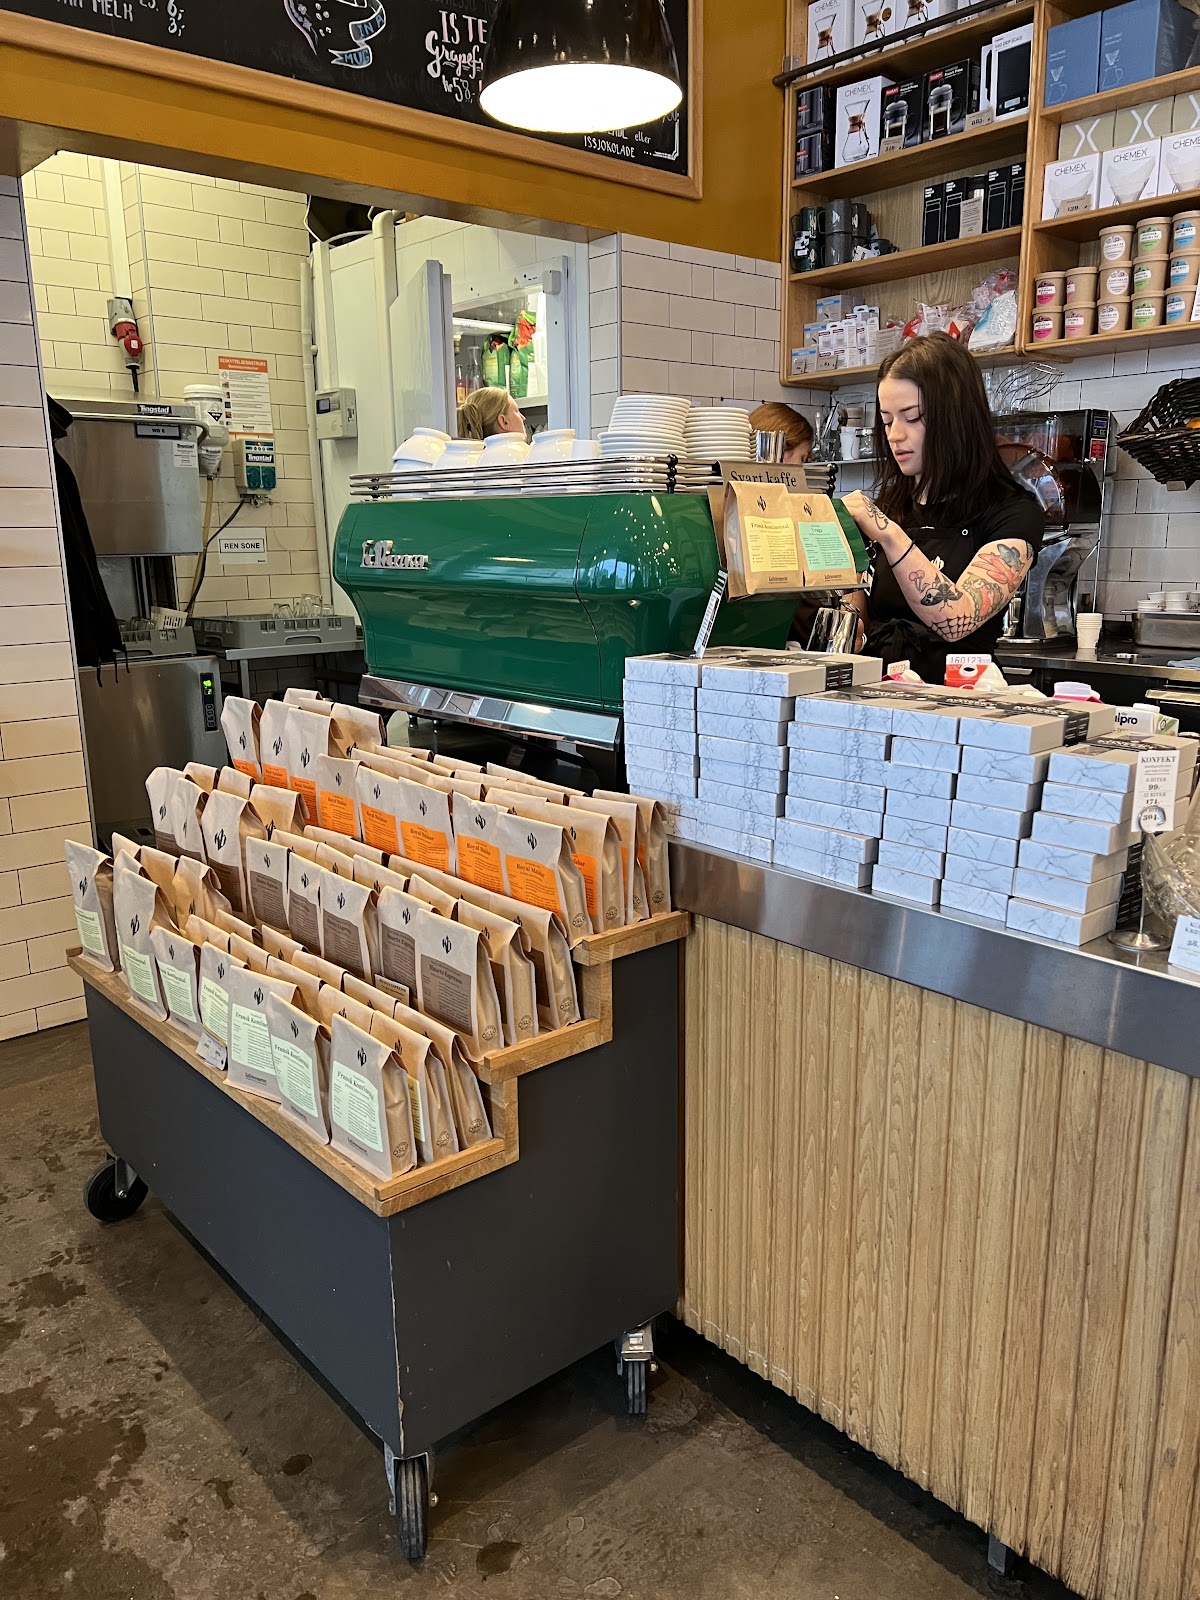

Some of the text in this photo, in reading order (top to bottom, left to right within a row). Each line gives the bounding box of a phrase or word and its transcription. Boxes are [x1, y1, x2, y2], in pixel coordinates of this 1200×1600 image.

[357, 24, 375, 38] IN
[439, 10, 488, 44] IS TE
[344, 49, 370, 65] MUG
[844, 84, 872, 97] CHEMEX
[634, 130, 652, 144] eller
[583, 135, 636, 158] ISSJOKOLADE
[1113, 148, 1148, 163] CHEMEX
[1054, 162, 1087, 177] CHEMEX
[139, 404, 170, 415] Tingstad
[247, 453, 273, 463] Tingstad
[765, 471, 798, 487] kaffe
[224, 542, 239, 550] REN
[1141, 756, 1177, 764] KONFEKT
